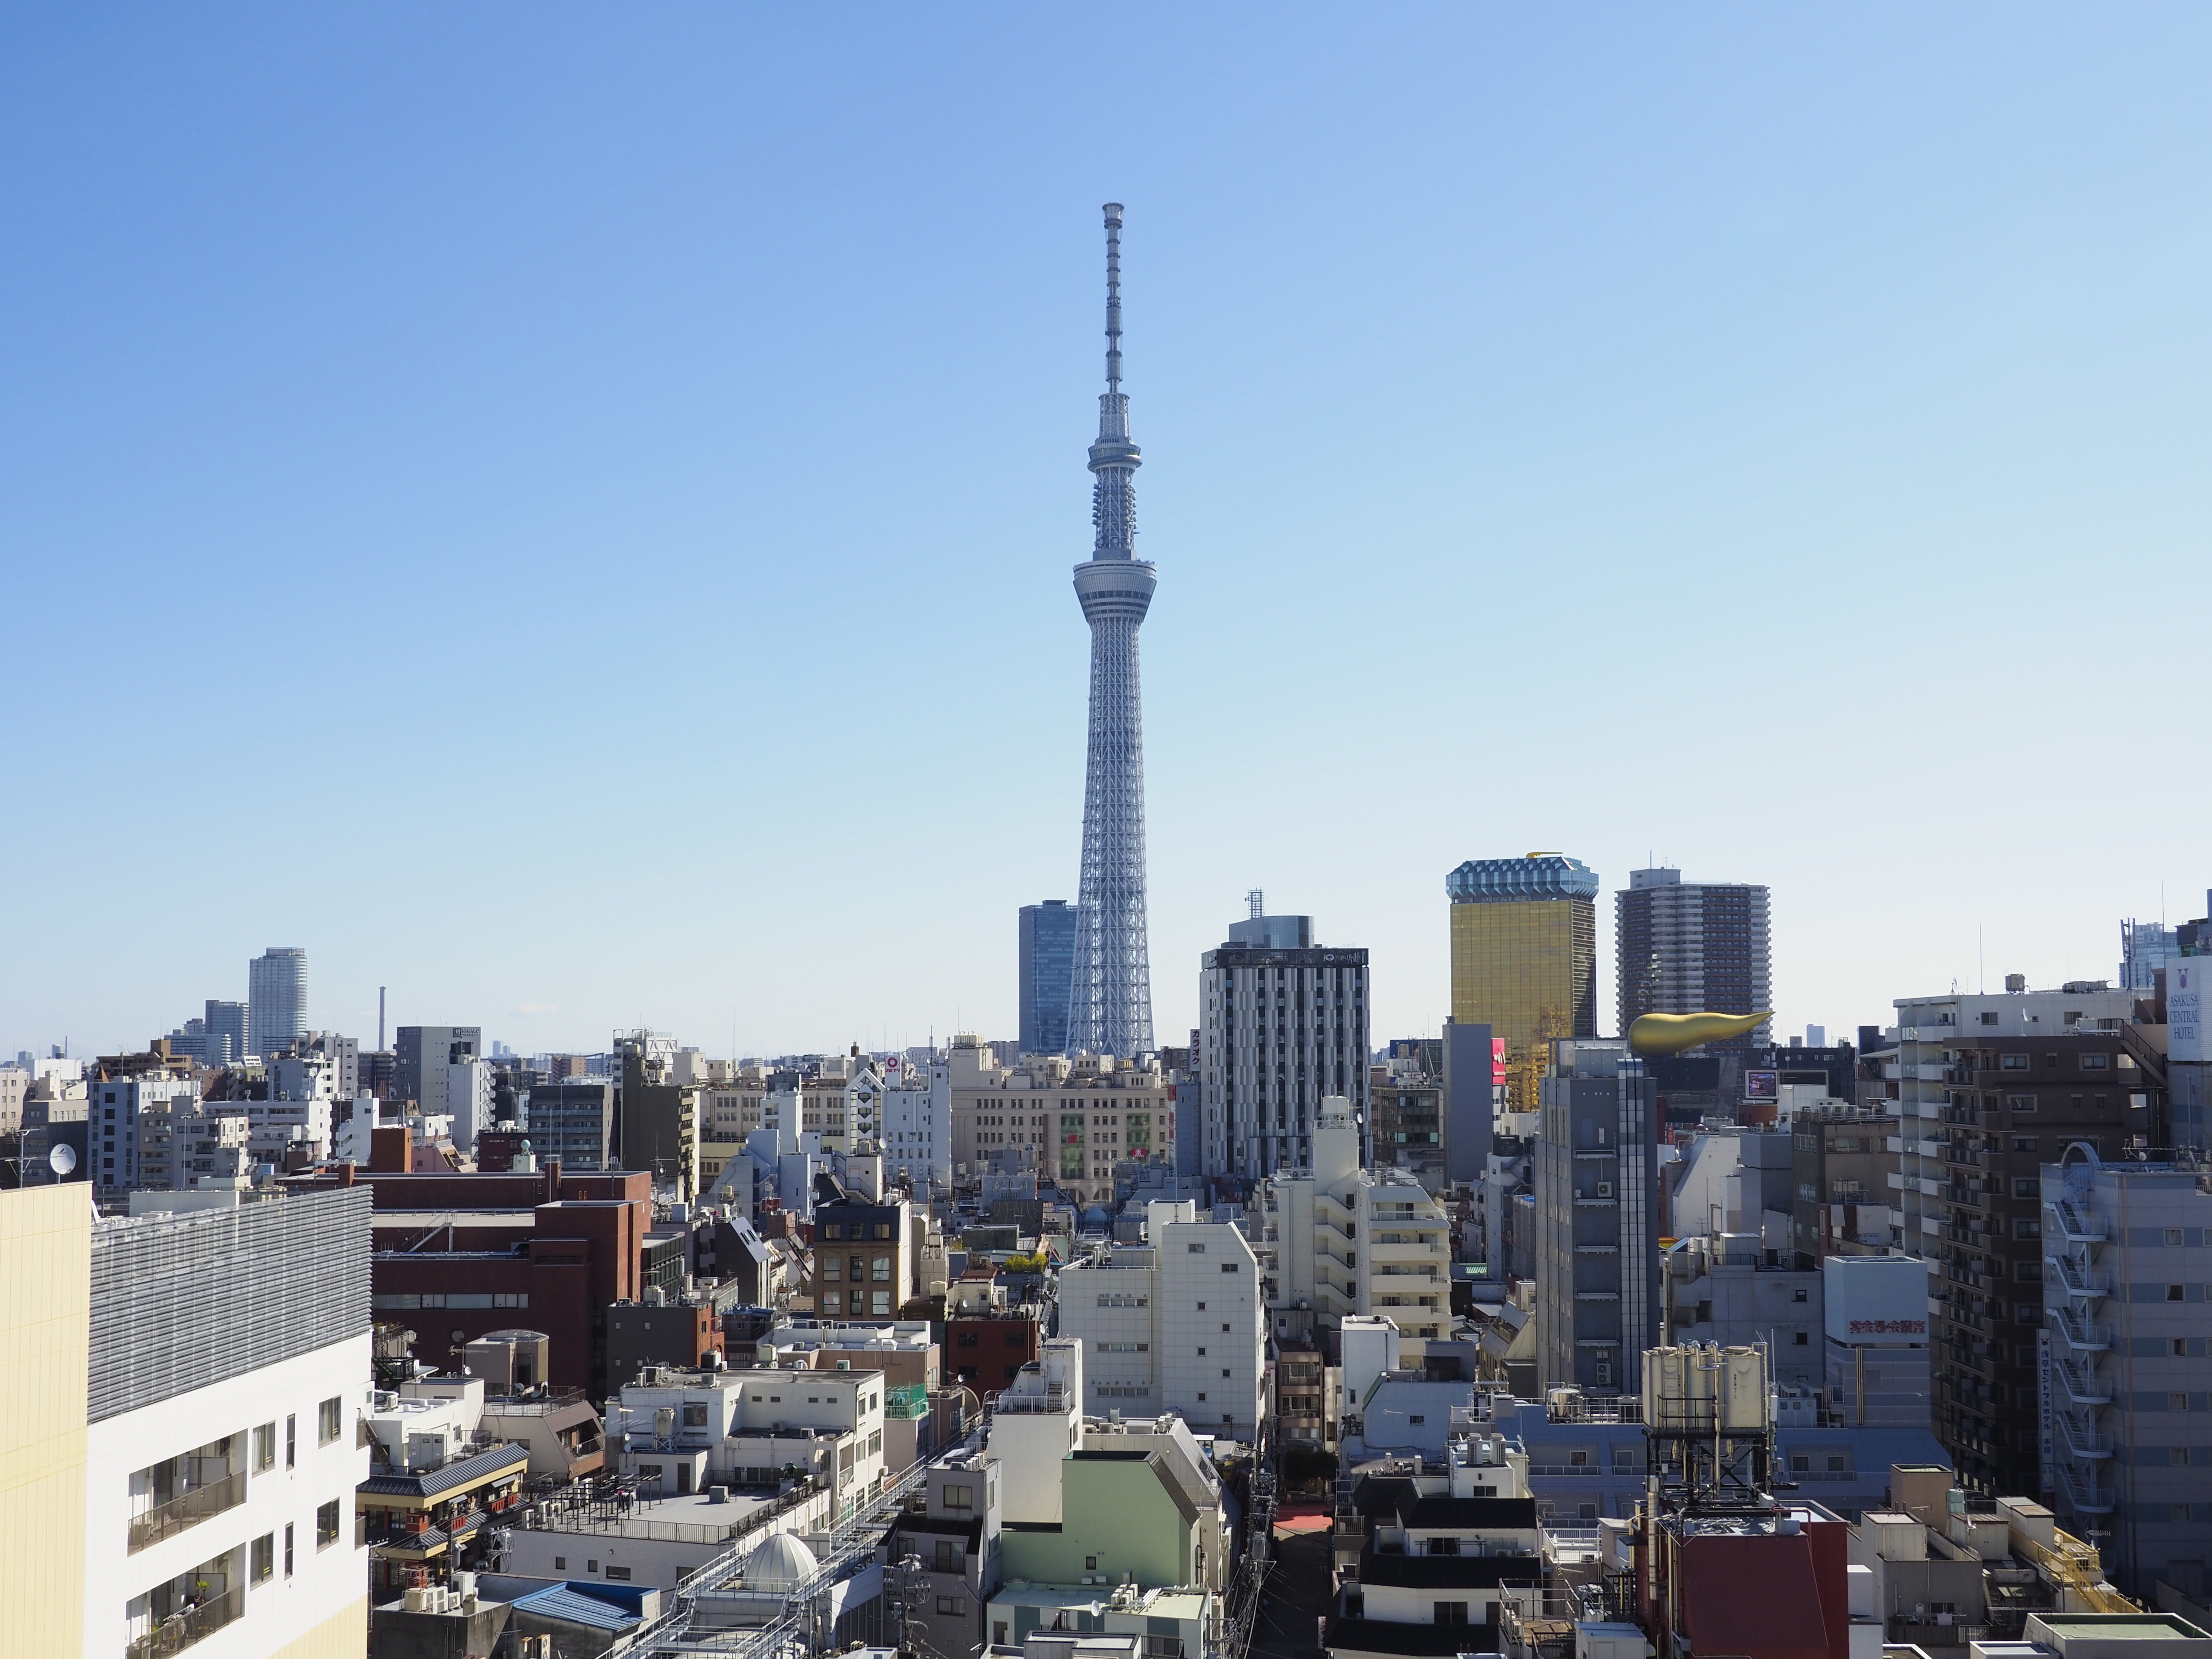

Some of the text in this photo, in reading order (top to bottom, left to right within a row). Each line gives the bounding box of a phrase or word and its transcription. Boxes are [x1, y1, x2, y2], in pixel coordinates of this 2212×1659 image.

[2170, 994, 2198, 1007] ASAKUSA
[2169, 1010, 2199, 1023] CENTRAL
[2174, 1027, 2195, 1039] HOTEL
[2041, 1350, 2050, 1430] 浅草セントラルホテル
